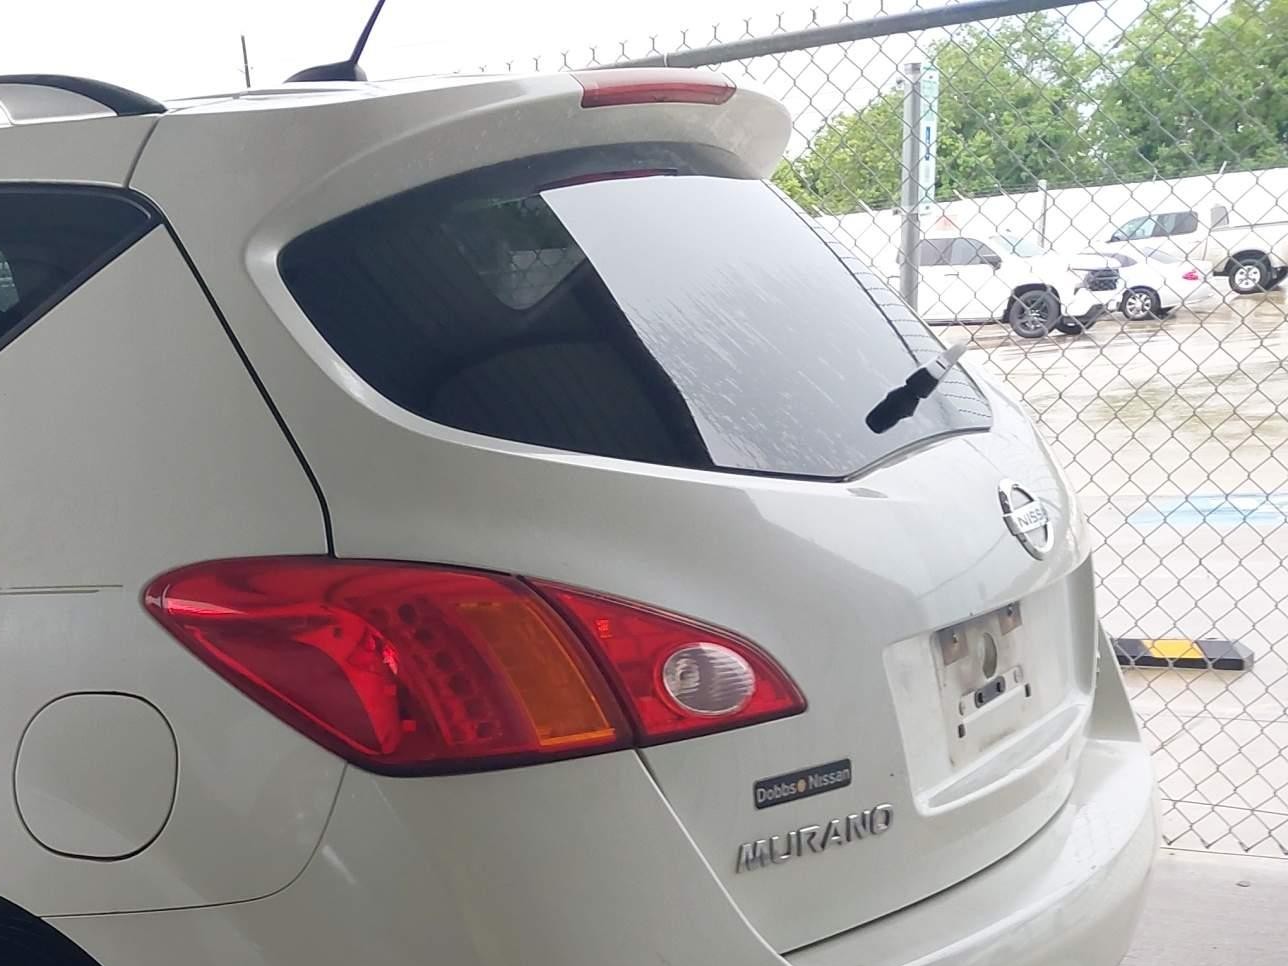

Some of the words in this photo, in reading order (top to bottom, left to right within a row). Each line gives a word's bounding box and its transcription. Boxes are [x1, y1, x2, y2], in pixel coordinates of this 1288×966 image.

[756, 782, 797, 803] Dobbs
[808, 768, 850, 790] Nissan
[736, 803, 894, 874] MURANO
